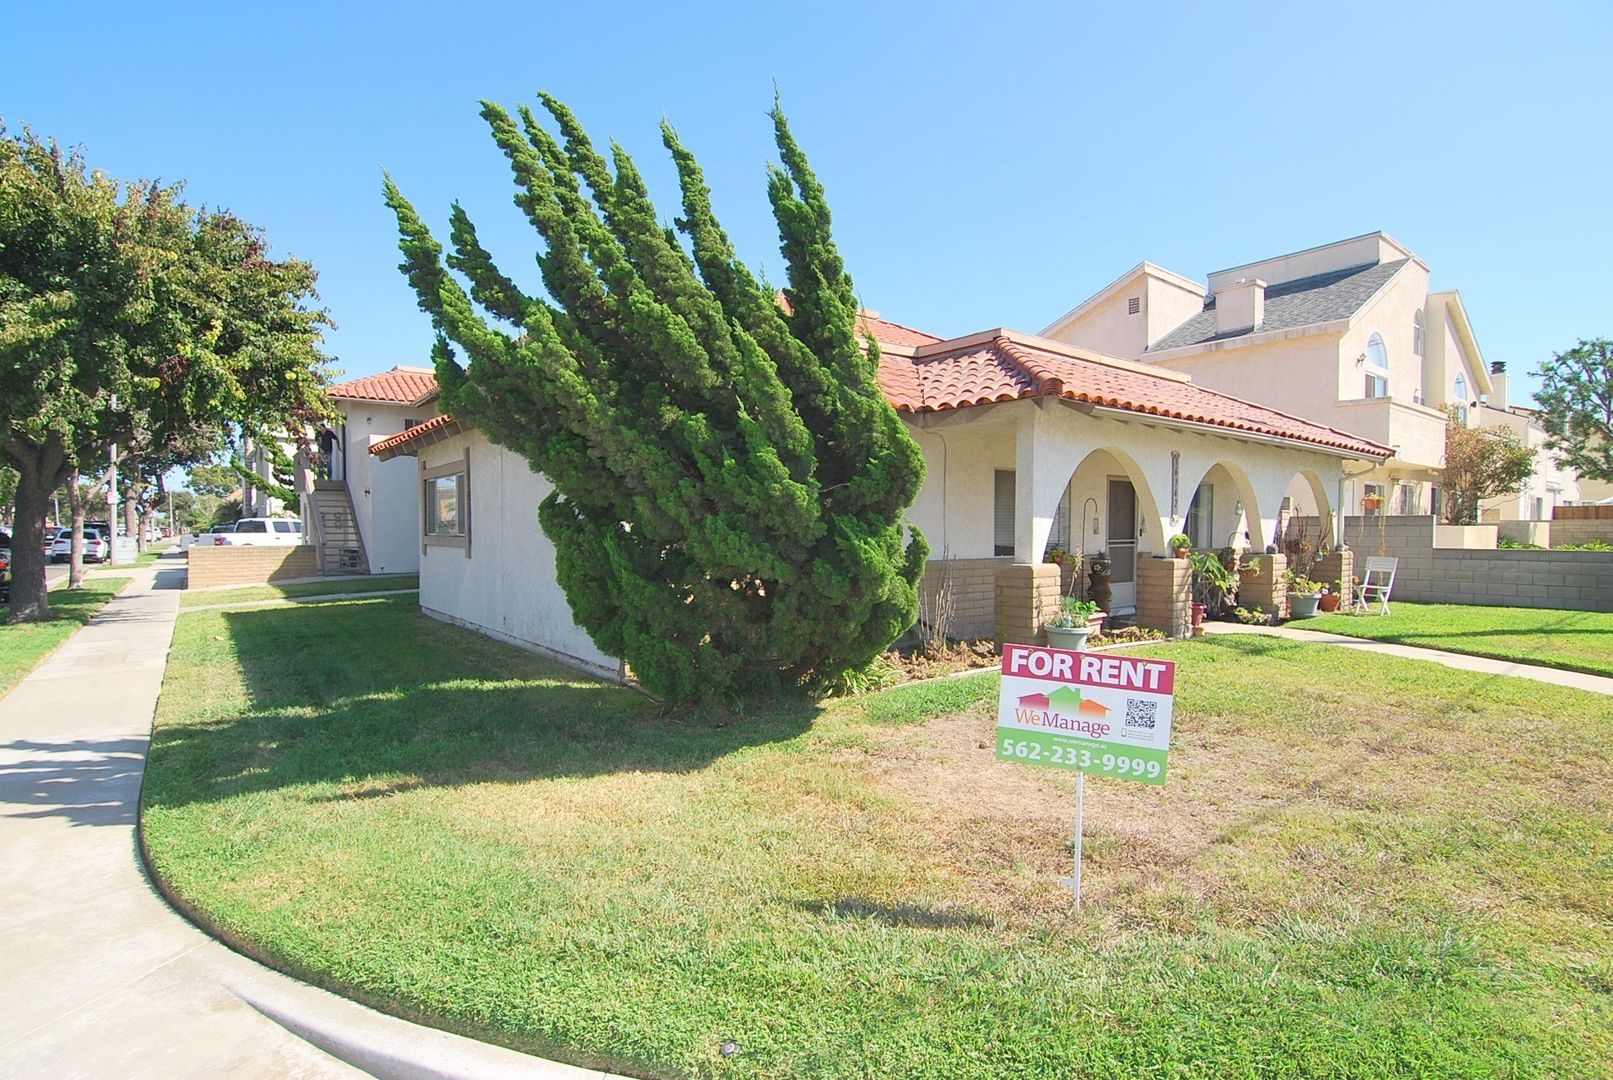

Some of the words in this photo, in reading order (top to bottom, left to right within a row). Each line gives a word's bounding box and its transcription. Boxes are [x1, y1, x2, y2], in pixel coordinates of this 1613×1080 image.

[1011, 649, 1073, 679] FOR
[1080, 656, 1165, 689] RENT
[1003, 739, 1160, 778] 562-233-9999
